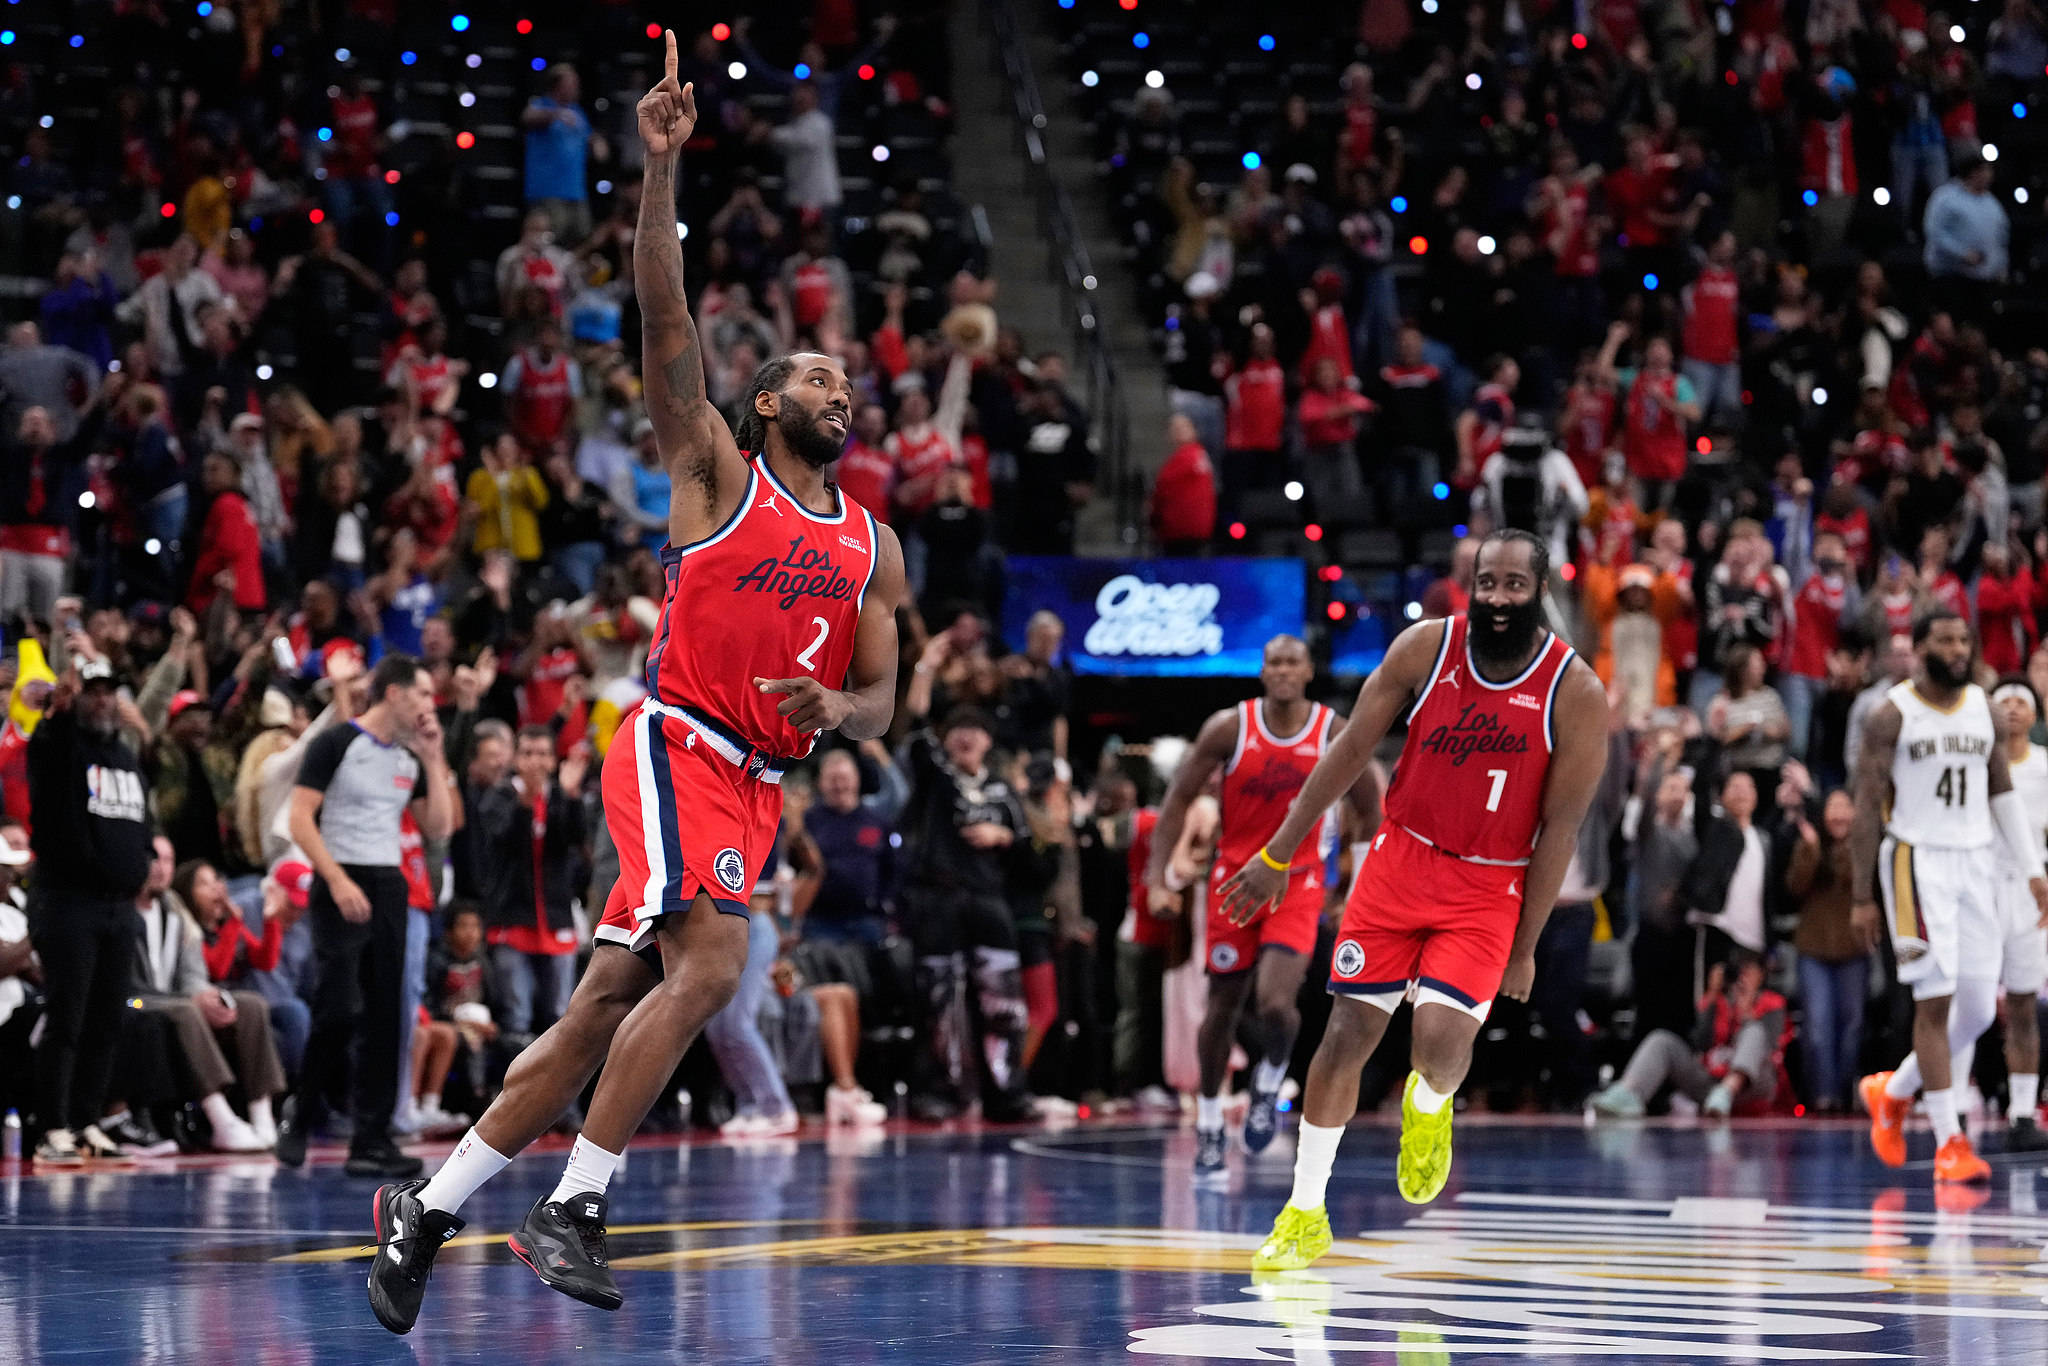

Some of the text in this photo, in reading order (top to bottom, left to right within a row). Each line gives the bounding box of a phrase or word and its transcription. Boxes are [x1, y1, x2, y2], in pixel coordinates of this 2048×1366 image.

[782, 535, 834, 570] Los
[841, 534, 860, 546] VISIT
[733, 558, 856, 610] Angeles
[796, 616, 830, 671] 2
[1452, 702, 1499, 732] Los
[1420, 725, 1528, 767] Angeles
[1486, 769, 1508, 812] 1
[1936, 765, 1967, 807] 41
